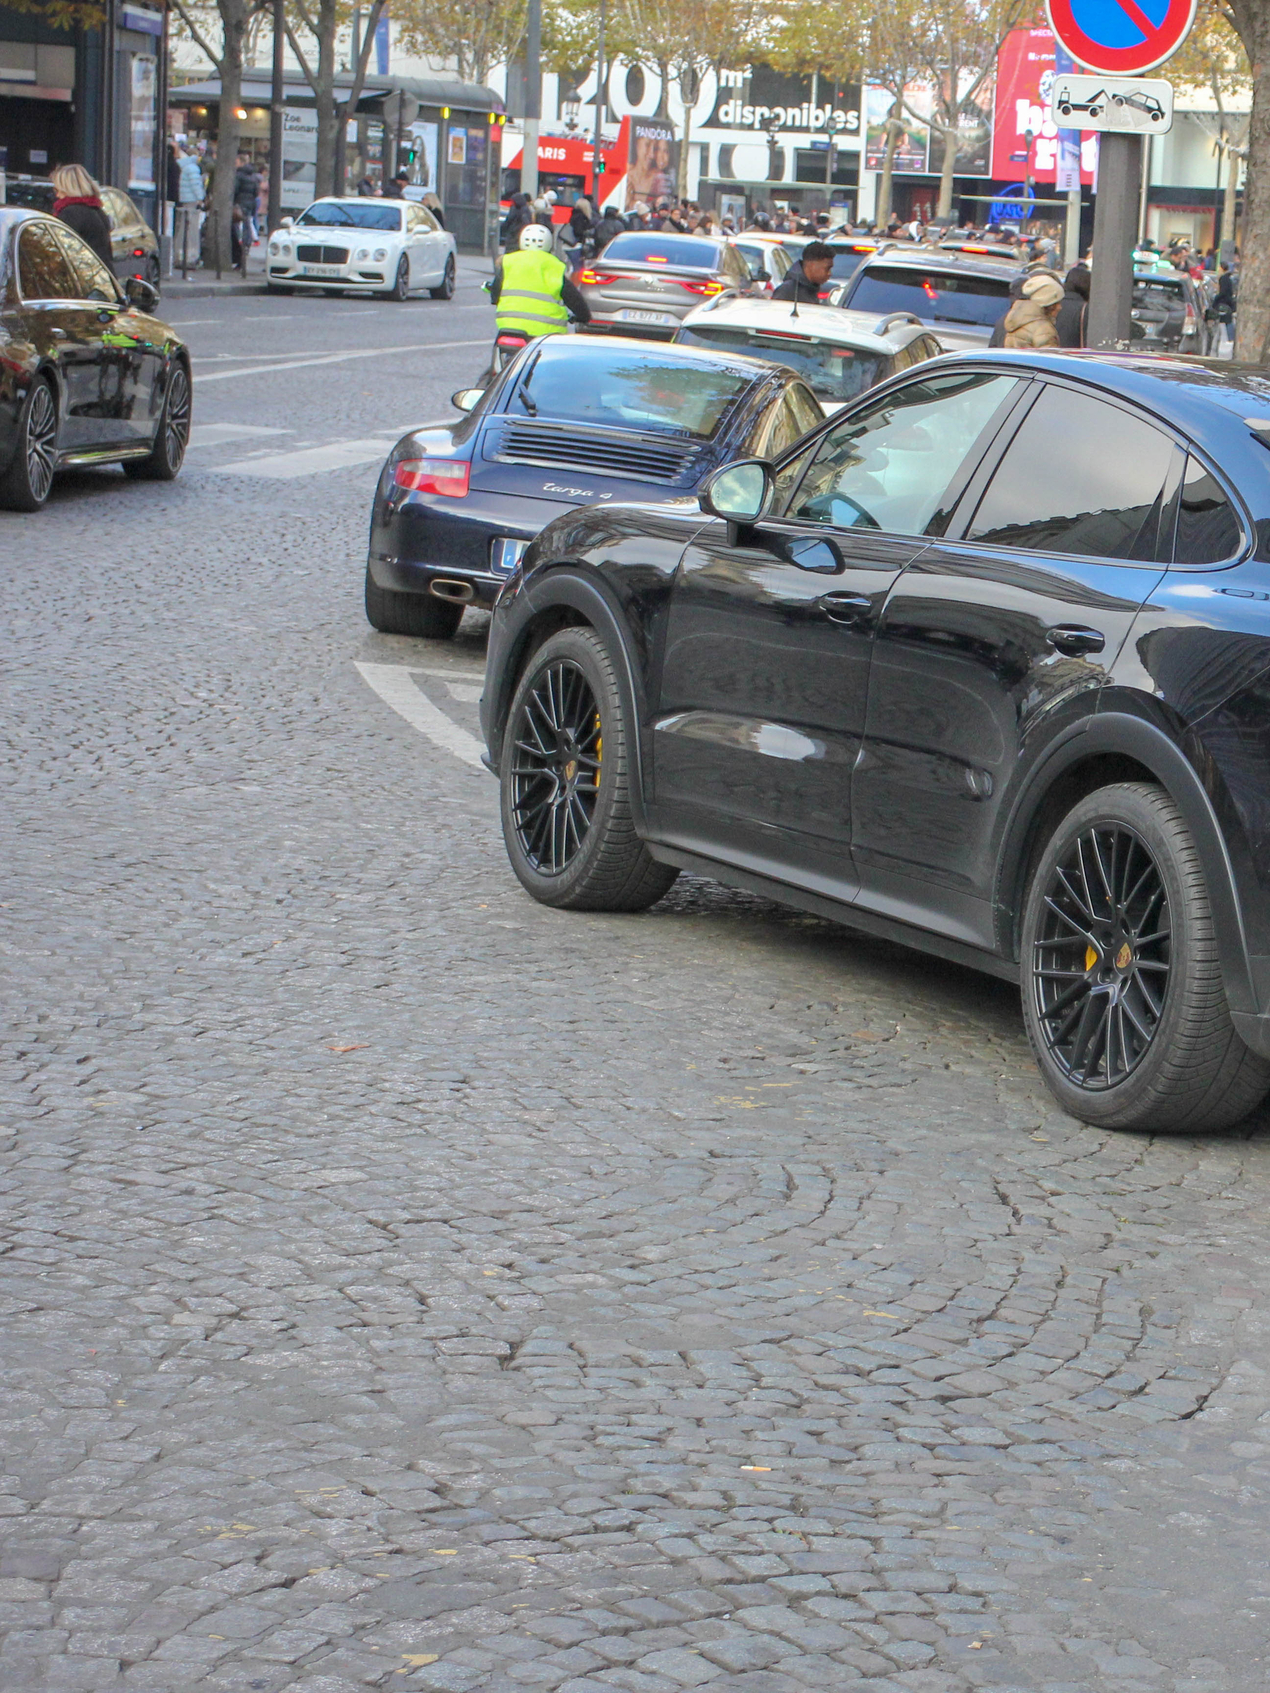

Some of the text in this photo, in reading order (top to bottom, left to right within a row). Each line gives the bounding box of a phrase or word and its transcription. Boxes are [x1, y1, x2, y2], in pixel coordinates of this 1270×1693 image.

[718, 99, 860, 130] disponibles
[283, 123, 319, 133] Leonar
[538, 145, 567, 160] ARIS
[542, 481, 594, 498] targa
